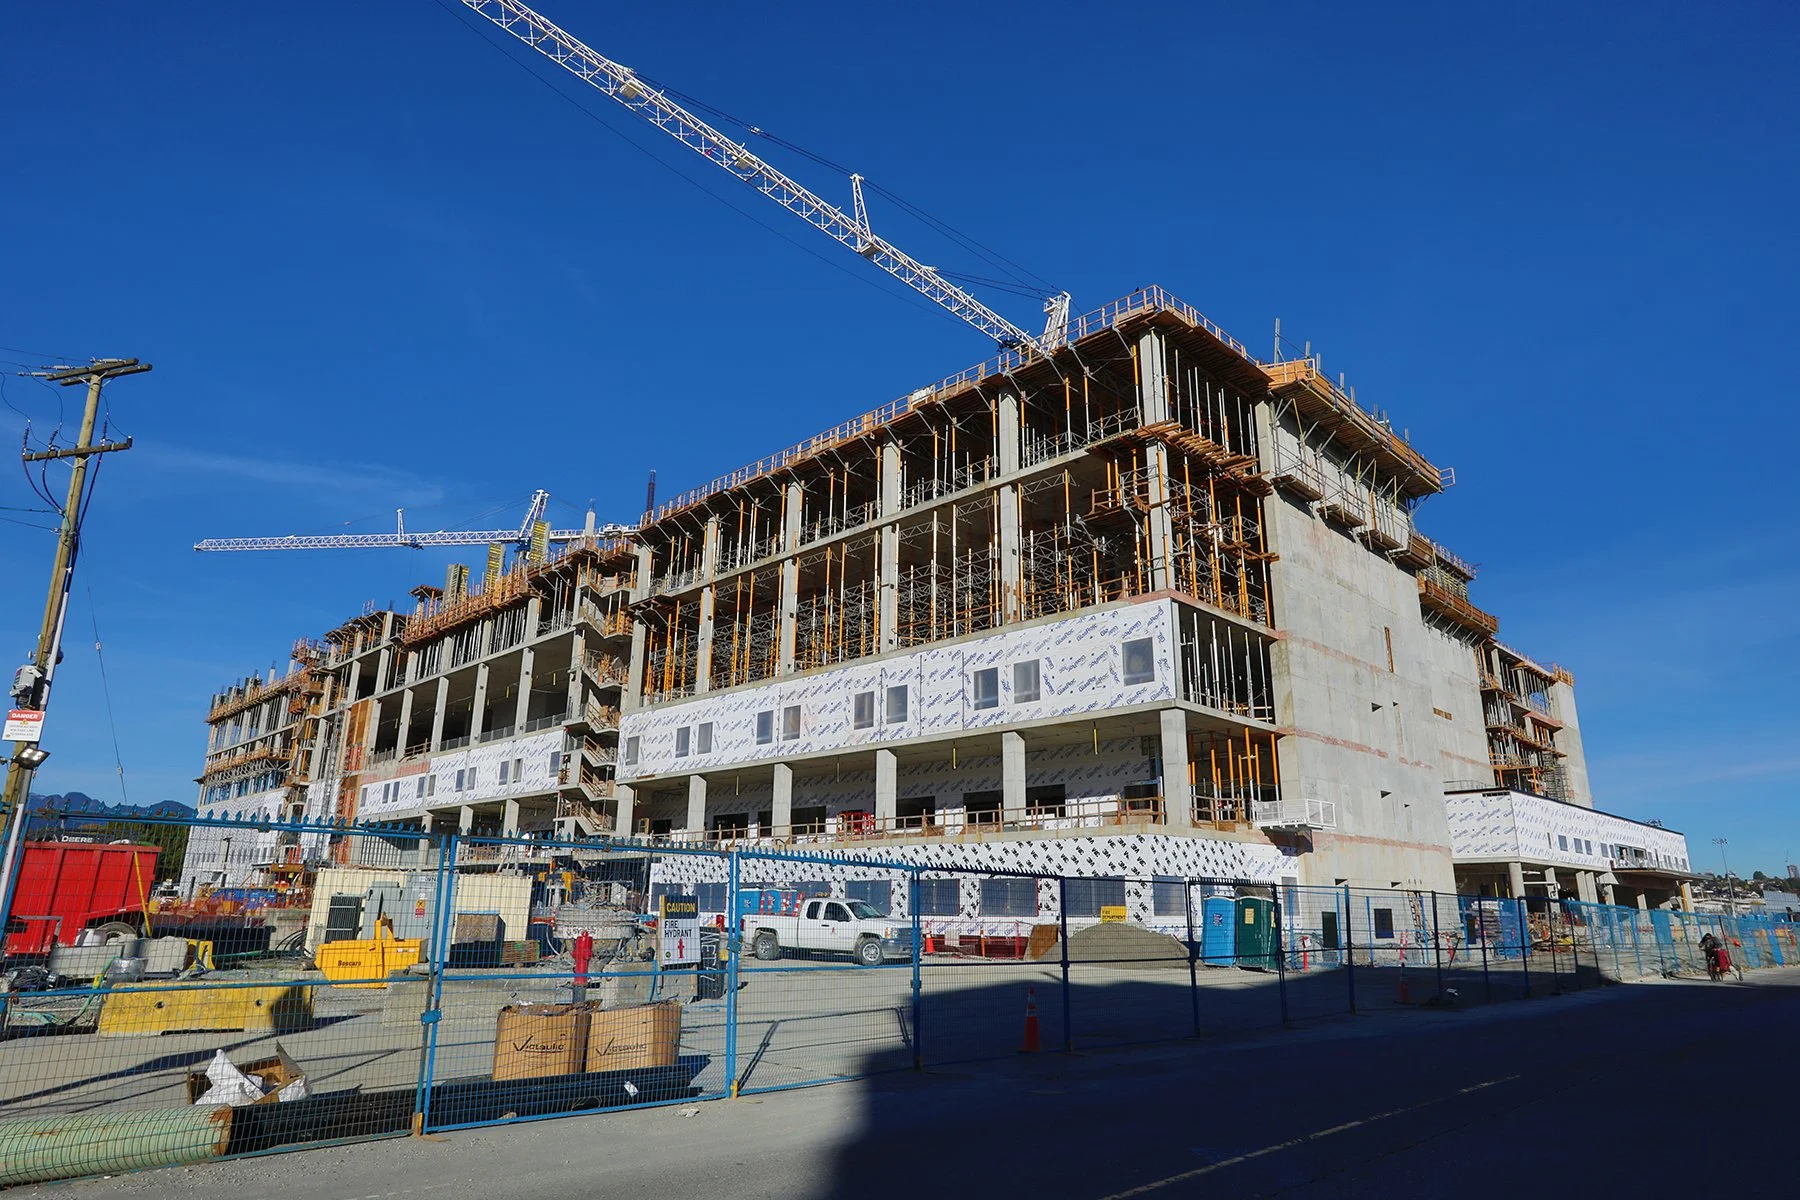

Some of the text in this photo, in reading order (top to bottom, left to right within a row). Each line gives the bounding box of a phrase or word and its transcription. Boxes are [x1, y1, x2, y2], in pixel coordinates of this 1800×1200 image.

[667, 903, 696, 912] CAUTION
[665, 929, 692, 937] HYDRANT
[513, 1036, 564, 1051] Victaulic
[596, 1037, 647, 1056] Victaulic
